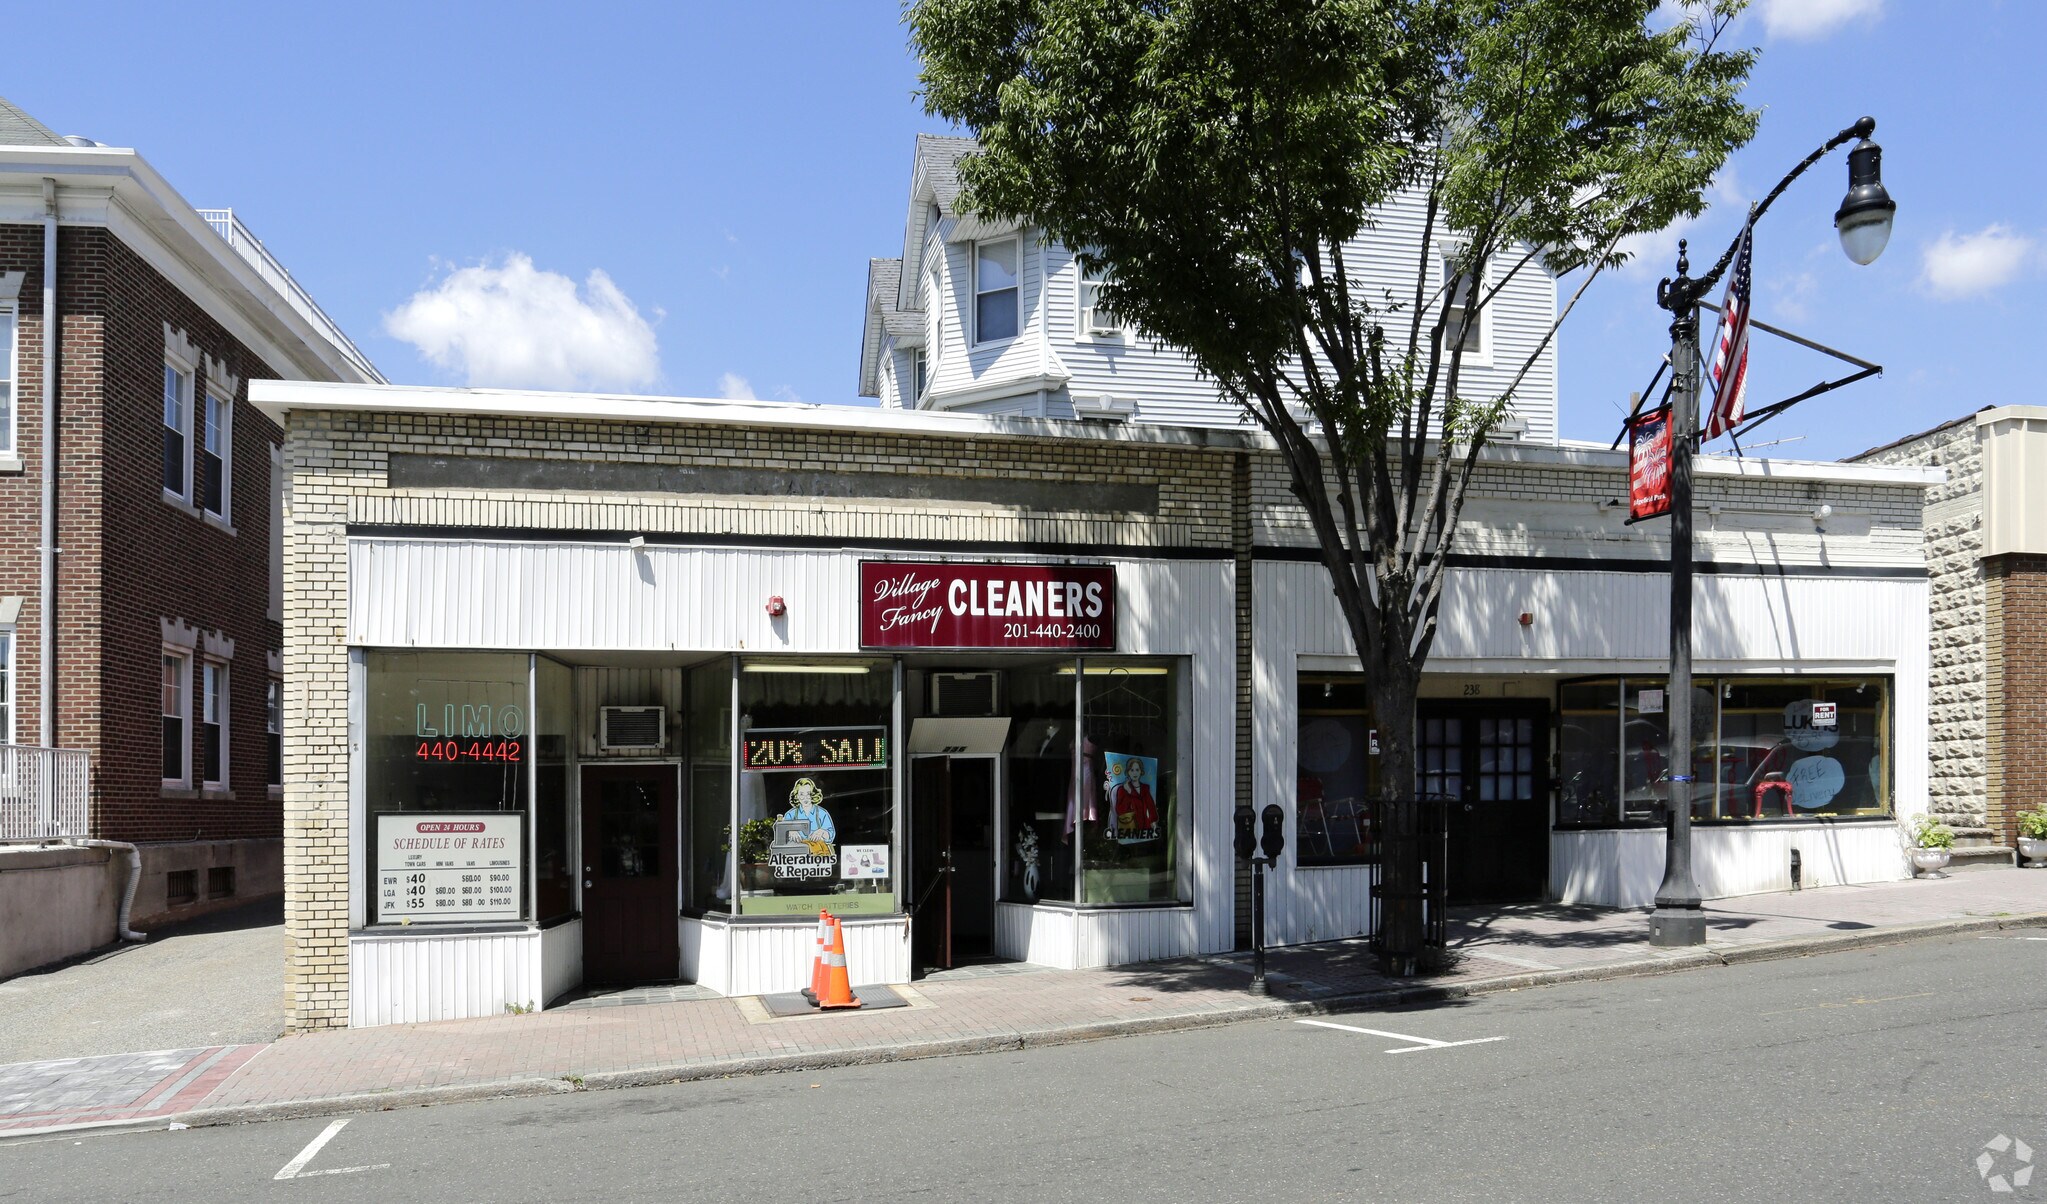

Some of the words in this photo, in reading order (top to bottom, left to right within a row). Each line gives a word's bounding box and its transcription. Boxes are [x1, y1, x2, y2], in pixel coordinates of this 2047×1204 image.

[1633, 496, 1653, 506] idgefield
[1654, 493, 1666, 501] Park
[873, 572, 941, 609] Village
[948, 578, 1103, 618] CLEANERS
[880, 605, 943, 633] Fancy
[1004, 623, 1100, 639] 201-440-2400
[1464, 684, 1480, 696] 238
[417, 703, 524, 739] LIMO
[1783, 715, 1839, 732] LUKS
[417, 741, 520, 761] 440-4442
[1790, 760, 1825, 786] FREE
[1104, 827, 1160, 840] CLEANERS
[393, 838, 450, 850] SCHEDULE
[454, 838, 467, 849] OF
[472, 838, 506, 849] RATES
[769, 853, 837, 866] Alterations
[406, 873, 426, 884] $40
[775, 867, 784, 877] &
[786, 866, 831, 881] Repairs
[384, 889, 396, 897] LGA
[406, 885, 426, 896] $40
[406, 898, 425, 909] $55
[786, 903, 812, 911] WATCH
